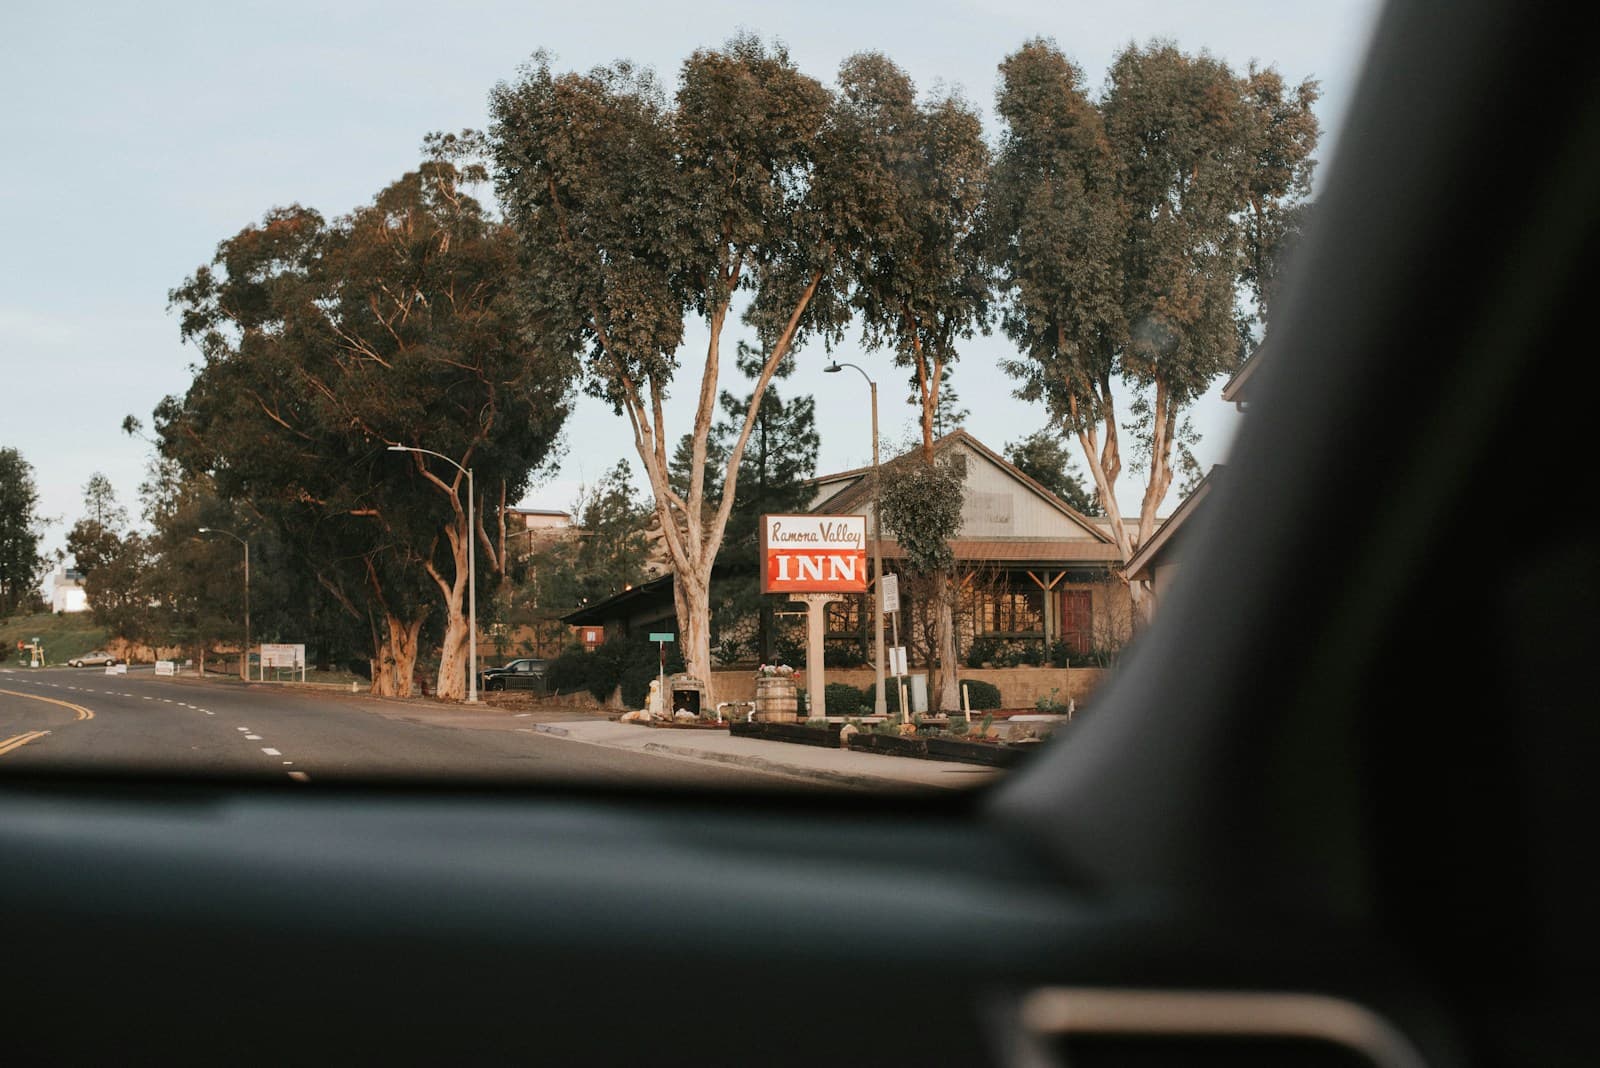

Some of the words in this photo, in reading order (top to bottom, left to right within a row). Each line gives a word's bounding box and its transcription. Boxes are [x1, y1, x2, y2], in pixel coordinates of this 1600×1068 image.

[772, 521, 819, 543] Ramona
[819, 522, 862, 549] Valley
[775, 555, 858, 581] INN
